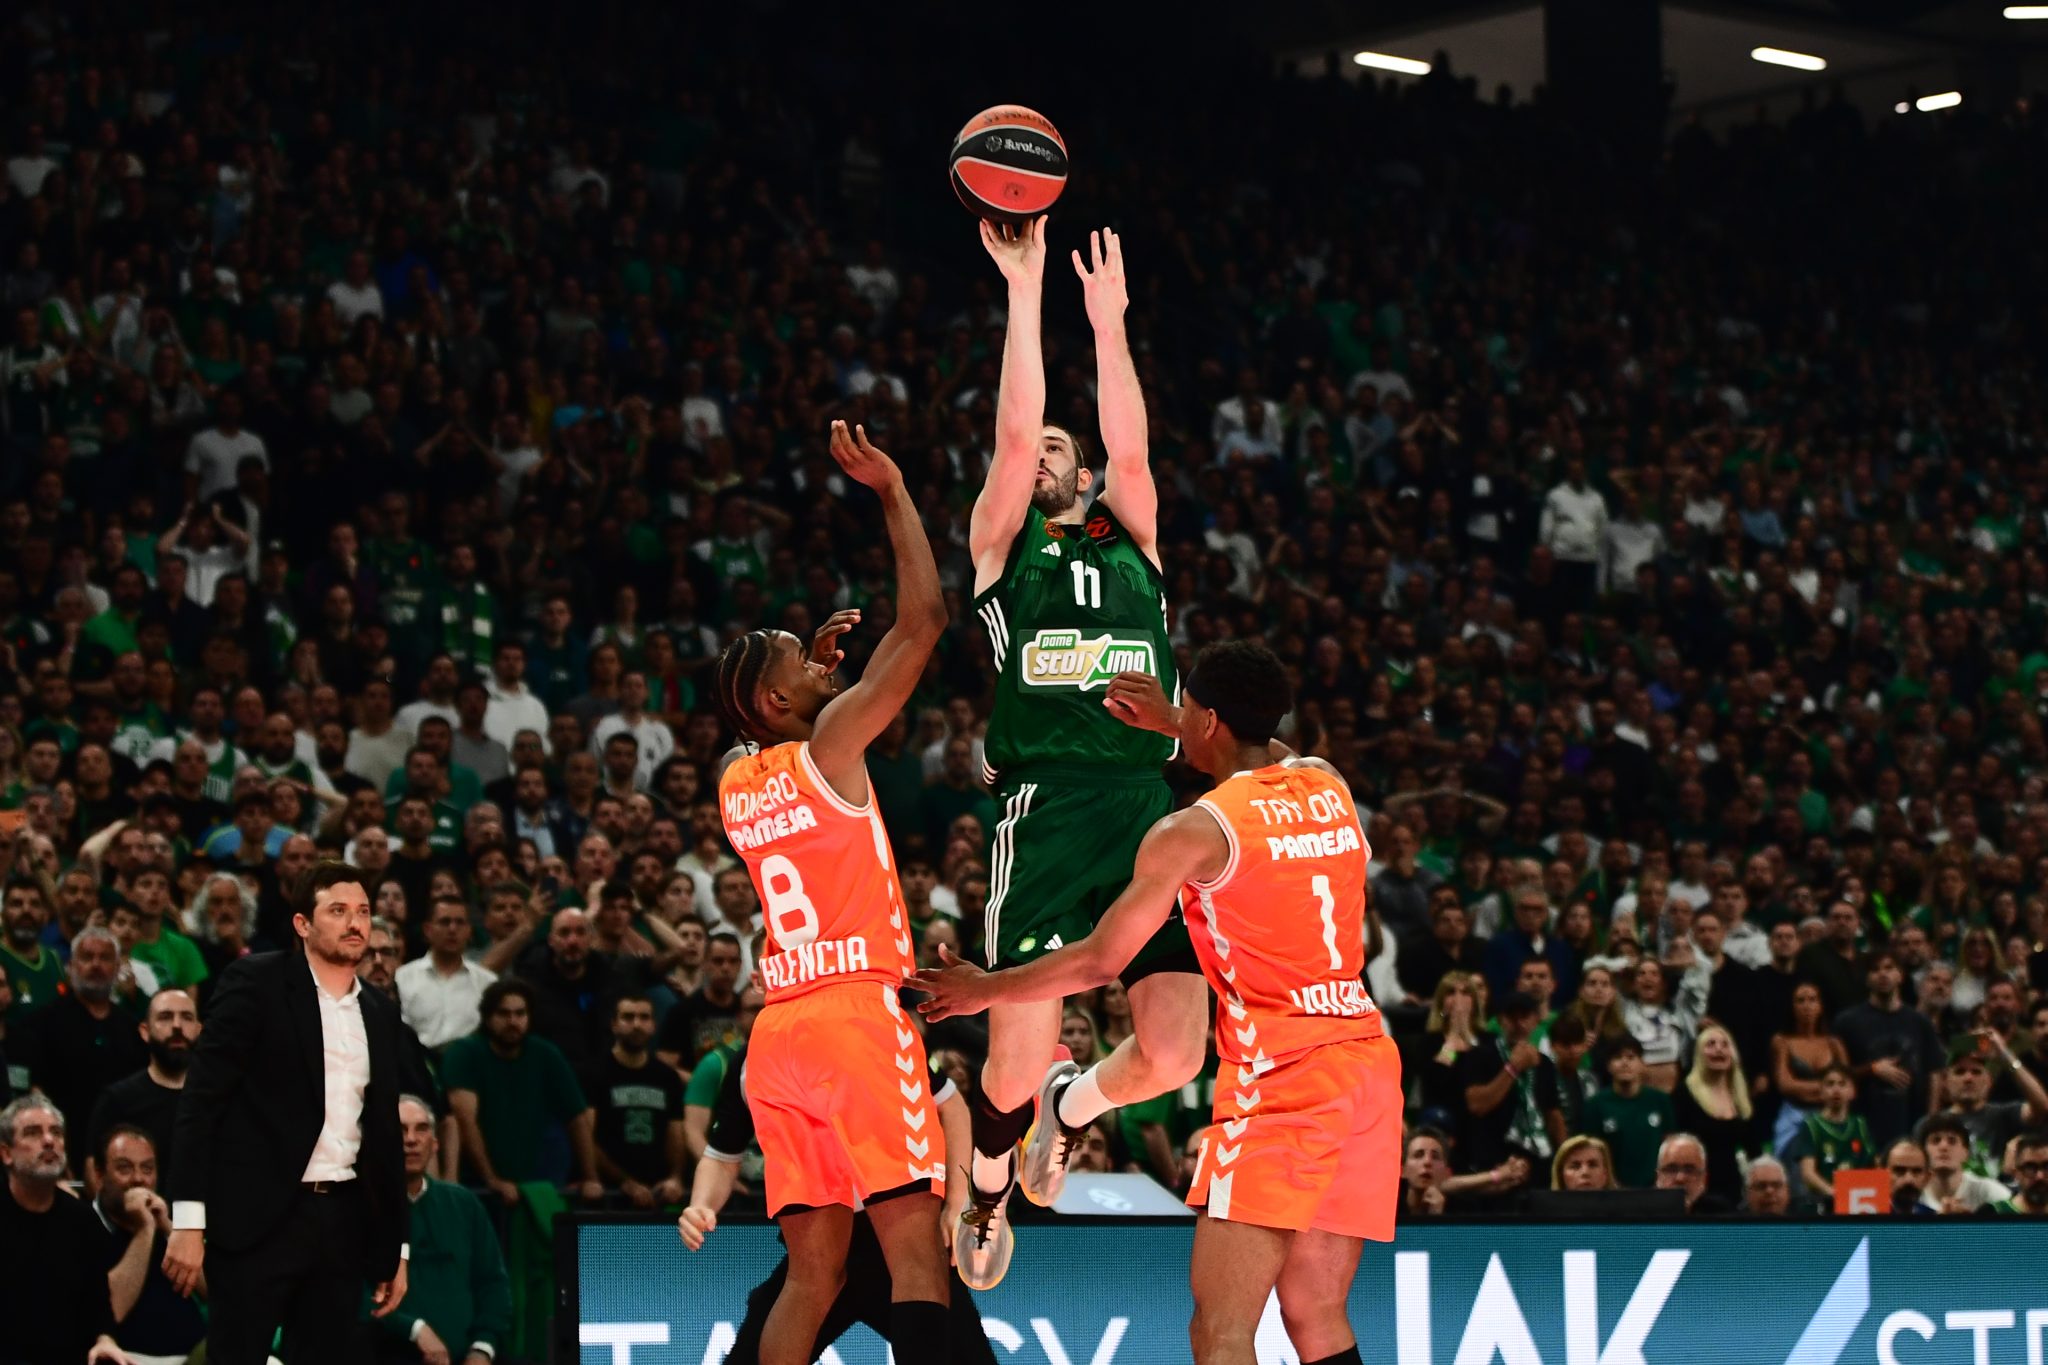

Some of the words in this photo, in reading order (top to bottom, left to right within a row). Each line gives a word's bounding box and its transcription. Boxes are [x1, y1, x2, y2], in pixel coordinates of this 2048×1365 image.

[1070, 560, 1101, 608] 11
[1041, 635, 1073, 648] pame
[729, 805, 818, 851] PAMESA
[1249, 789, 1349, 825] TAYOR
[1266, 826, 1360, 860] PAMESA
[760, 854, 819, 951] 8
[1311, 875, 1342, 970] 1
[759, 936, 869, 991] ALENCIA
